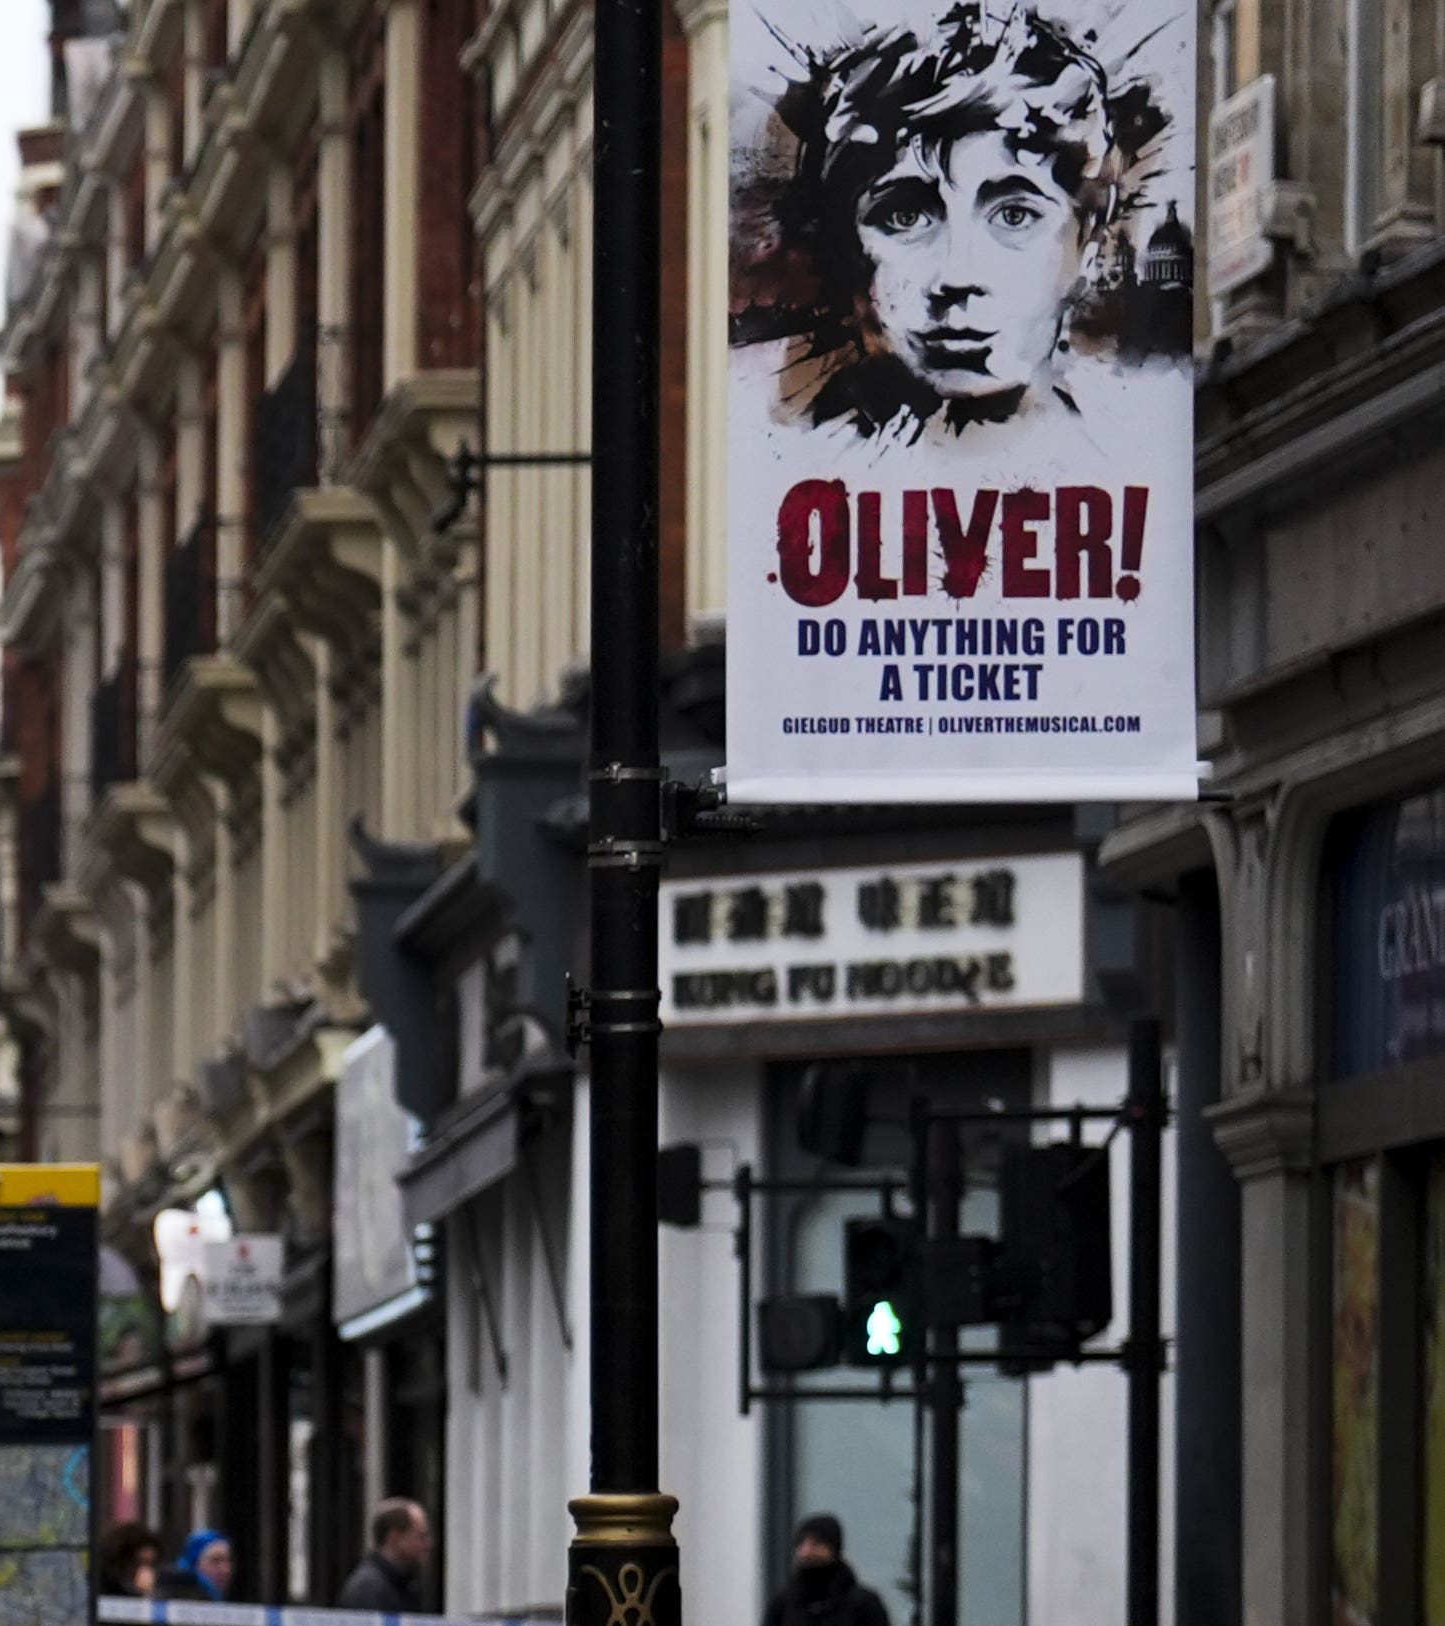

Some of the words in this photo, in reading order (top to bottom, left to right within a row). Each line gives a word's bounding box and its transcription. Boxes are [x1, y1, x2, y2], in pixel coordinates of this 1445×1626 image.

[777, 479, 1149, 607] OLIVER!
[798, 619, 847, 656] DO
[857, 618, 1045, 656] ANYTHING
[1057, 618, 1126, 655] FOR
[879, 664, 903, 701] A
[913, 664, 1043, 701] TICKET
[782, 717, 851, 735] GIELGUD
[855, 717, 924, 734] THEATRE
[938, 716, 1141, 734] OLIVERTHEMUSICAL.COM
